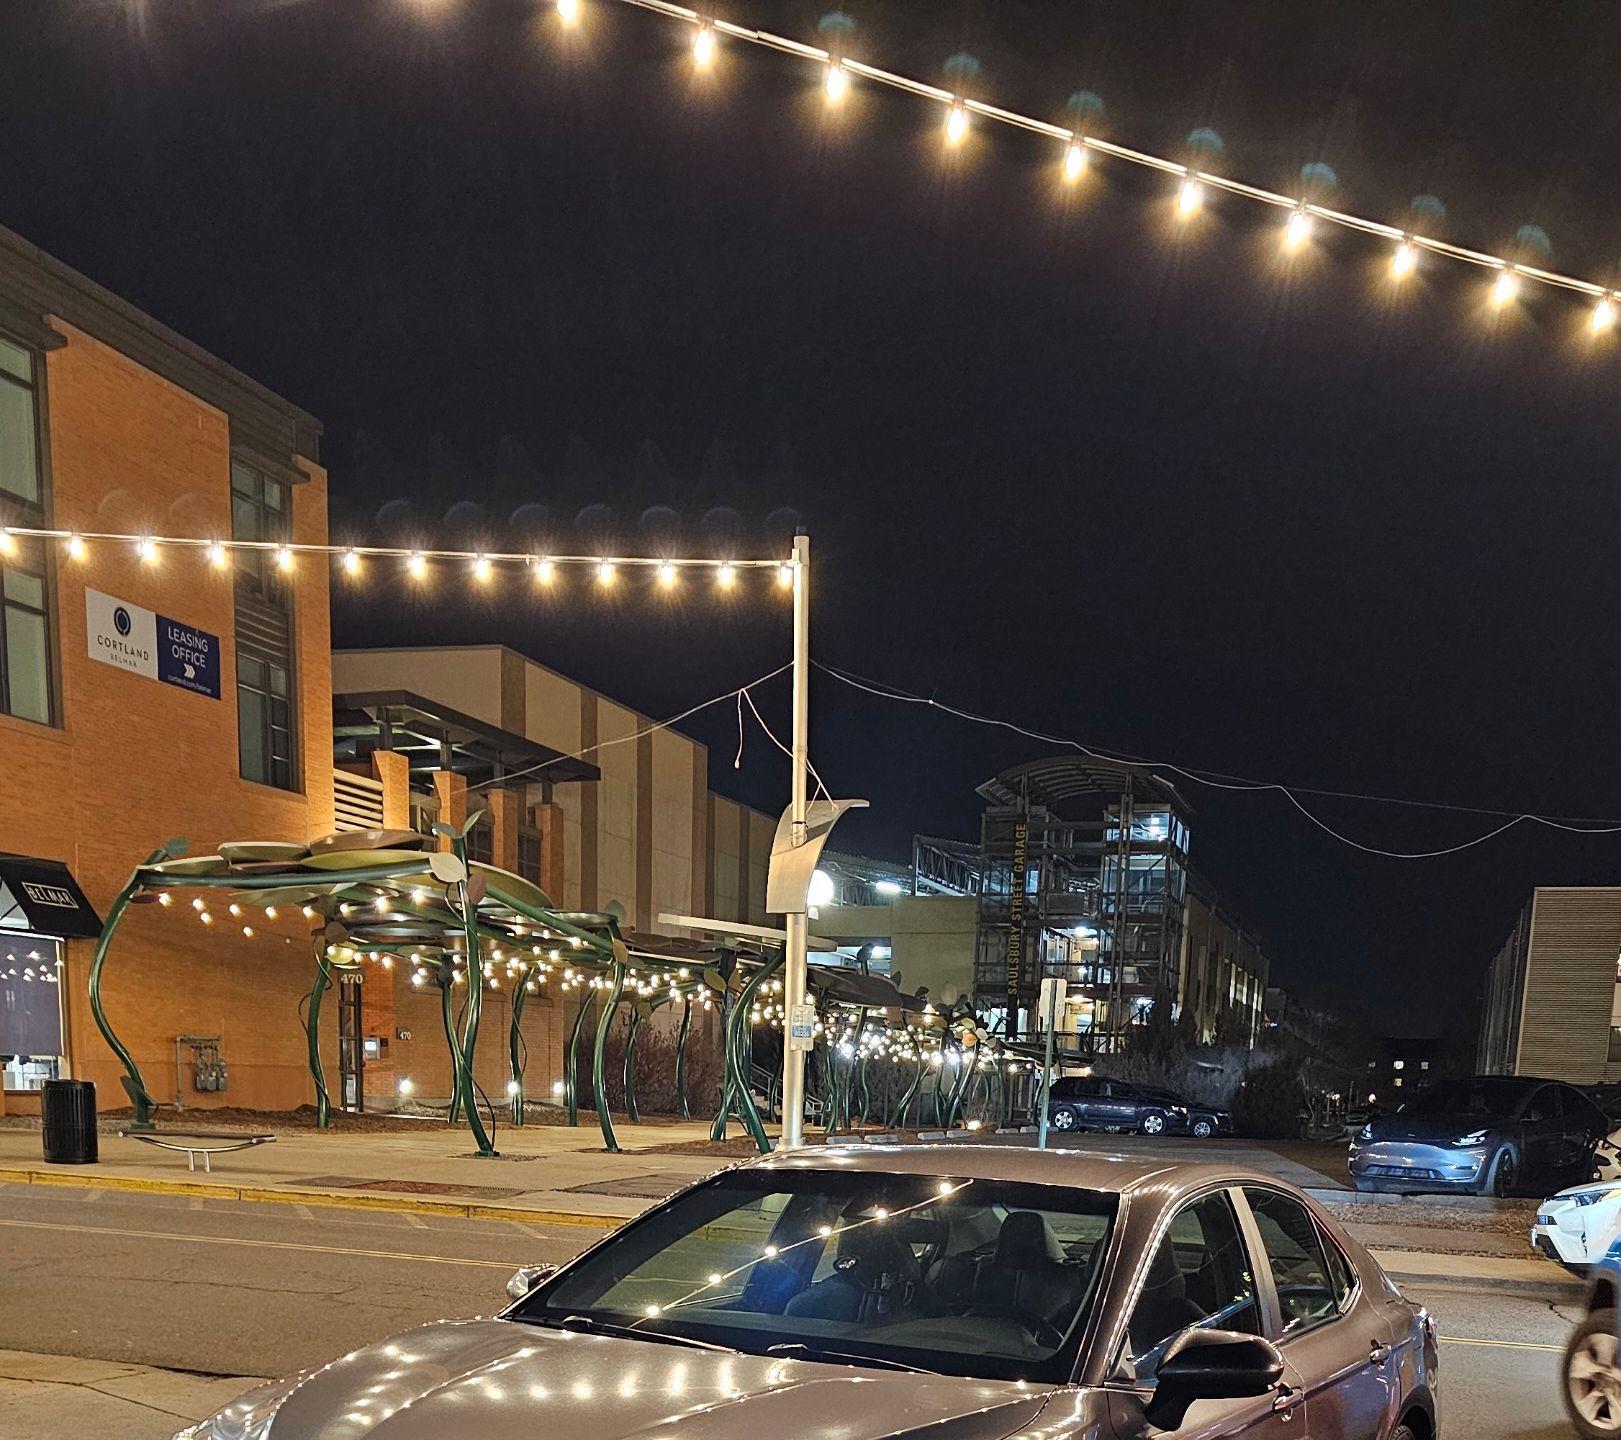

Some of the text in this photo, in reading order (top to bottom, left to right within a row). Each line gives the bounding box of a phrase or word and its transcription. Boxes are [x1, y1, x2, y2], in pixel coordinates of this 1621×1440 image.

[97, 634, 149, 661] CORTLAND
[168, 625, 208, 652] LEASING
[171, 644, 206, 668] OFFICE
[27, 885, 72, 904] BELMAR
[1008, 824, 1026, 995] SAULSBURY STREET GARAGE
[341, 973, 363, 984] 470
[400, 1031, 412, 1040] 470
